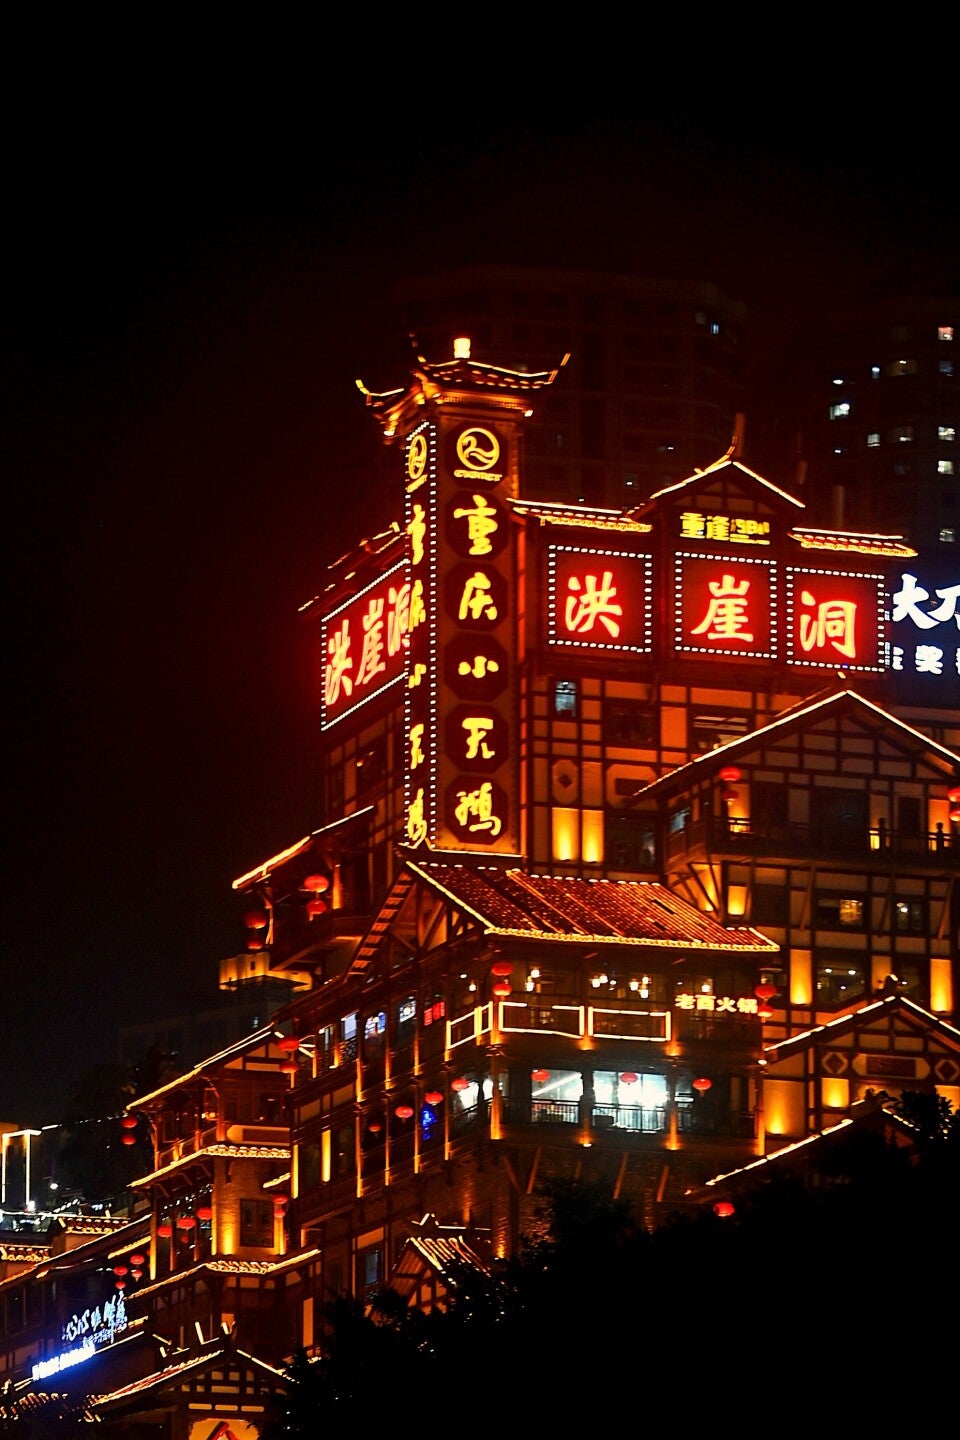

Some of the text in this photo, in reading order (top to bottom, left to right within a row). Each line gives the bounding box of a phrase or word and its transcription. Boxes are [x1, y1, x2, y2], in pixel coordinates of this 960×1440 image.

[324, 583, 412, 706] 洪崖洞
[564, 570, 859, 659] 洪崖洞
